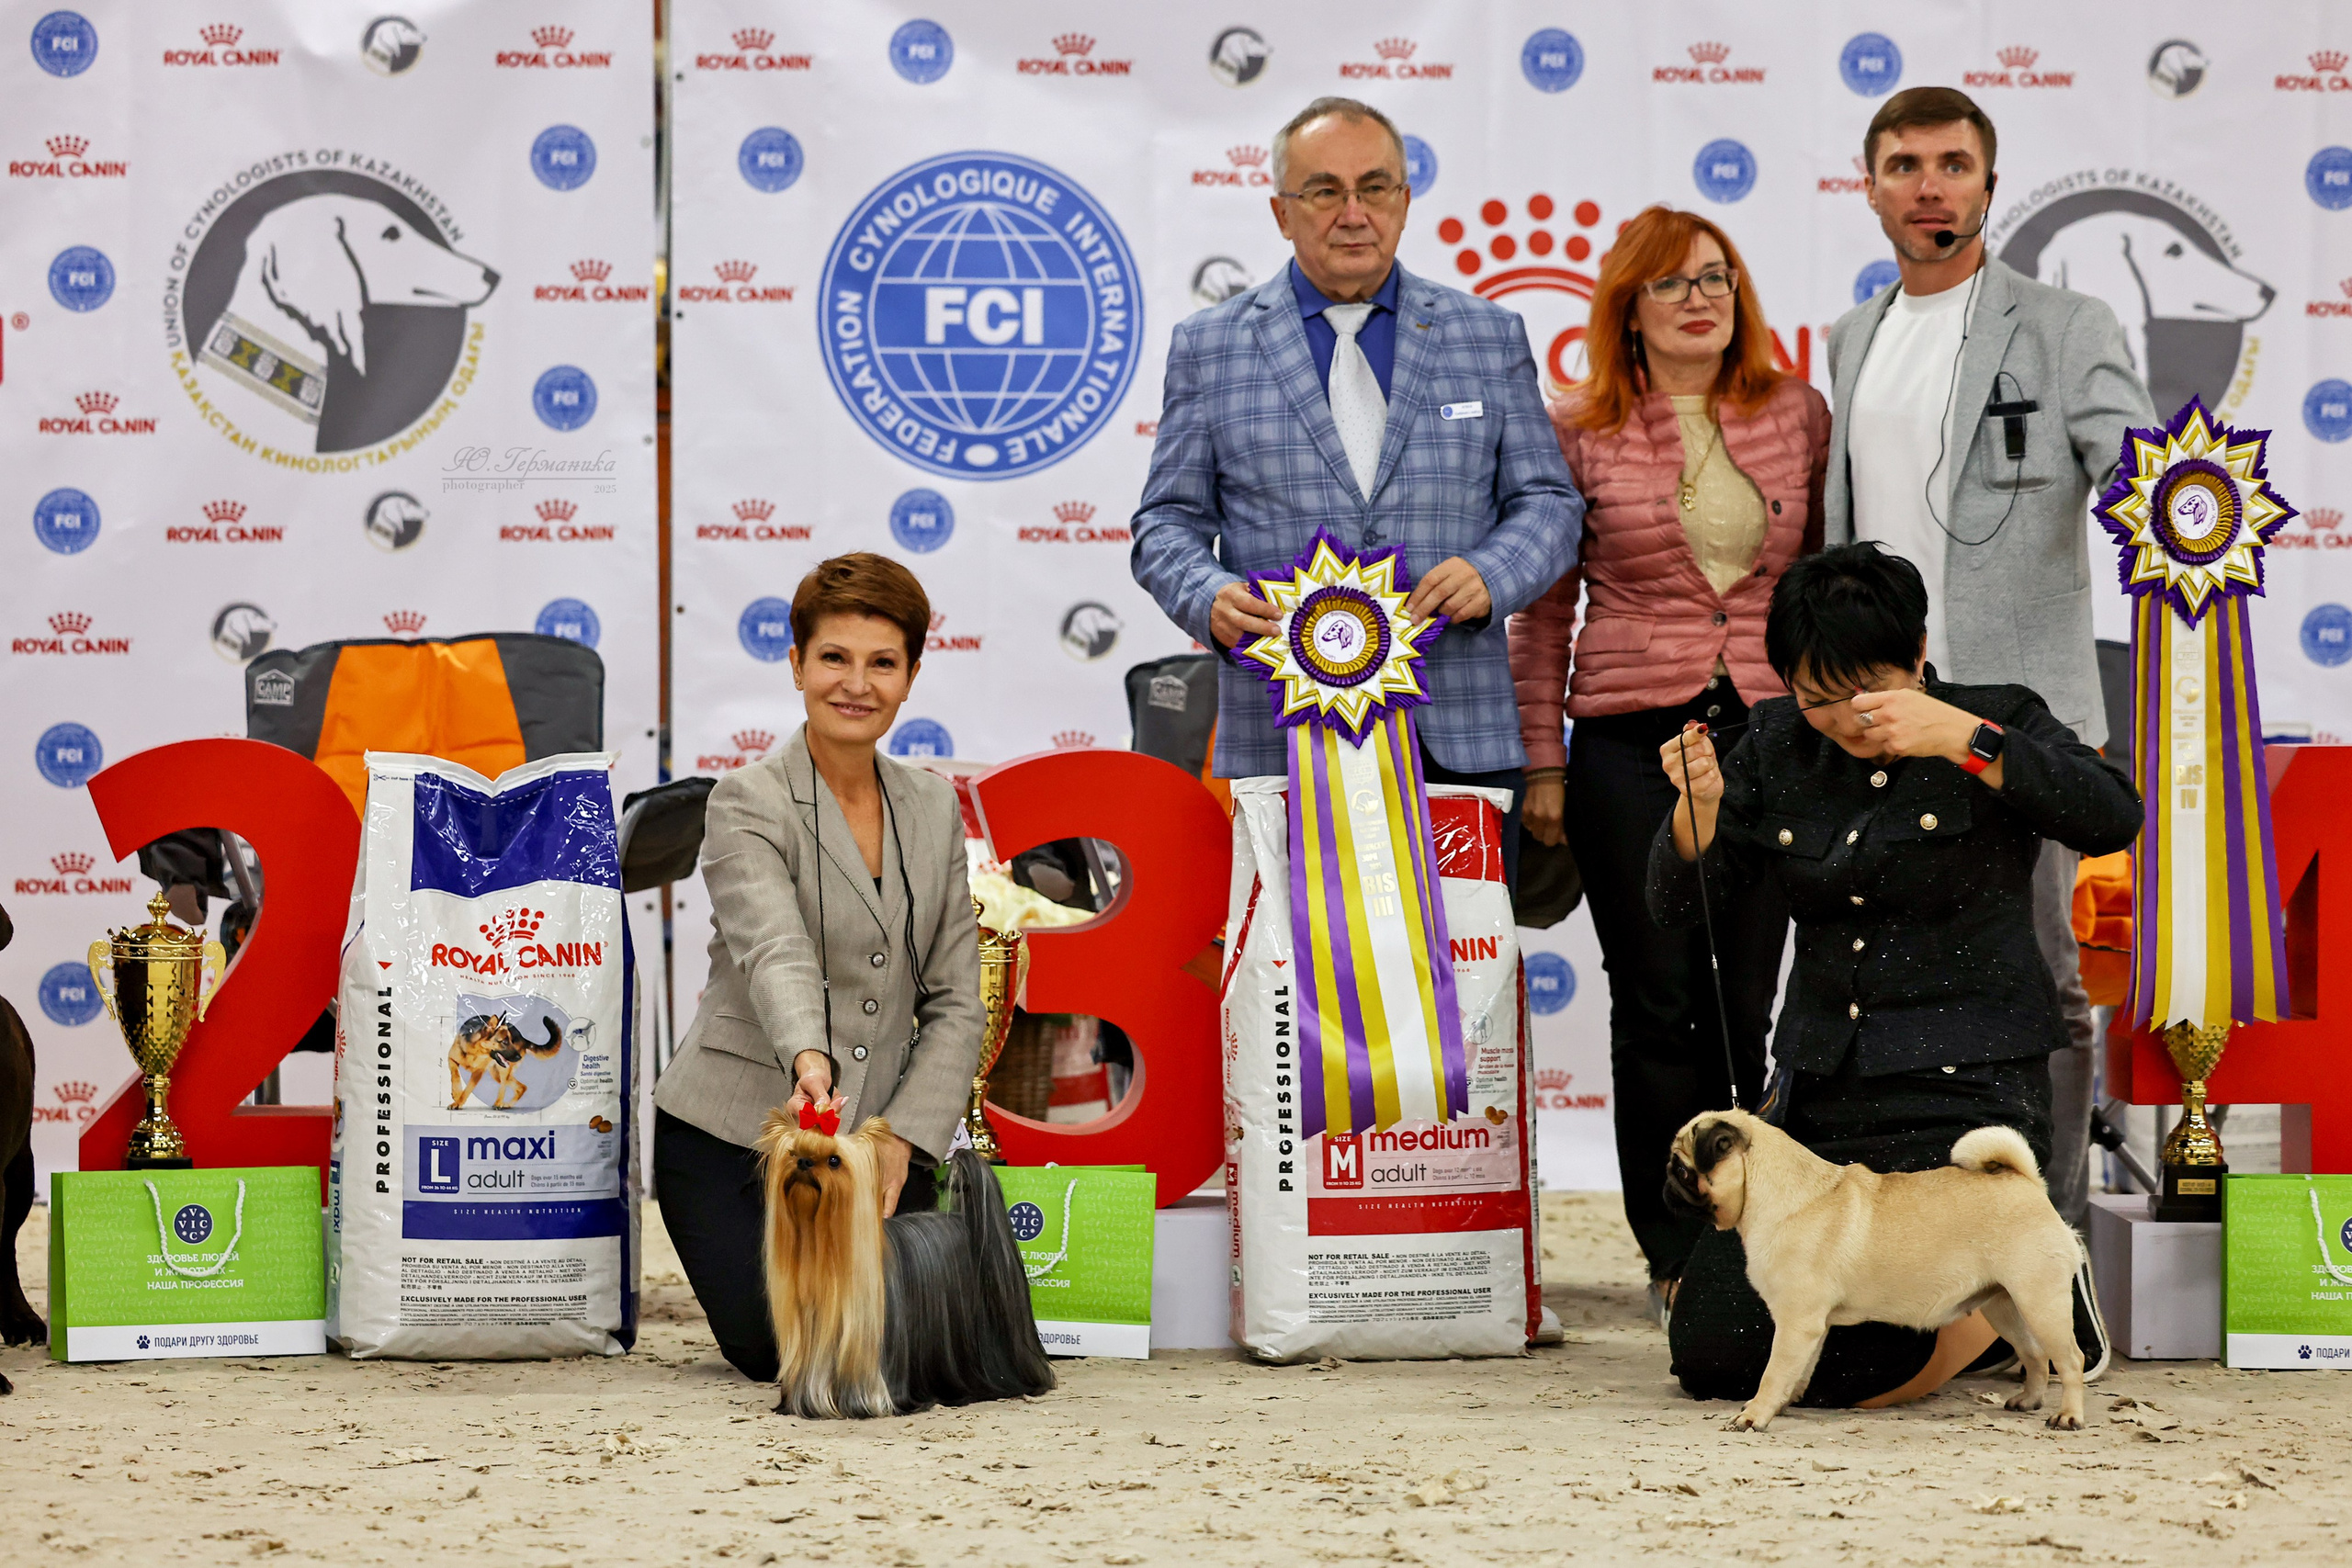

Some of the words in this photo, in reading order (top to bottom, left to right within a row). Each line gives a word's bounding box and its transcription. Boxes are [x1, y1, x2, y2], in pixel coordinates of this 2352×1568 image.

[51, 36, 78, 51] FCI
[164, 51, 216, 66] ROYAL
[910, 44, 934, 59] FCI
[496, 52, 548, 67] ROYAL
[696, 55, 748, 70] ROYAL
[1018, 60, 1069, 74] ROYAL
[315, 149, 343, 164] OF
[551, 151, 577, 164] FCI
[758, 152, 785, 166] FCI
[9, 161, 62, 177] ROYAL
[185, 150, 309, 240] CYNOLOGISTS
[349, 152, 464, 243] KAZAKHSTAN
[1990, 169, 2098, 253] YNOLOGISTS
[848, 168, 1060, 273] CYNOLOGIQUE
[169, 242, 188, 271] OF
[69, 271, 96, 286] FCI
[534, 286, 586, 300] ROYAL
[679, 288, 730, 301] ROYAL
[163, 276, 181, 348] UNION
[924, 287, 1045, 345] FCI
[1004, 210, 1127, 465] INTERNATIONALE
[836, 289, 958, 464] FEDERATION
[553, 391, 579, 405] FCI
[39, 418, 92, 434] ROYAL
[54, 513, 81, 528] FCI
[910, 513, 935, 527] FCI
[166, 526, 219, 543] ROYAL
[225, 526, 283, 542] CANIN
[499, 526, 551, 541] ROYAL
[696, 525, 748, 540] ROYAL
[1018, 527, 1069, 542] ROYAL
[758, 622, 785, 637] FCI
[11, 638, 65, 655] ROYAL
[71, 638, 130, 654] CANIN
[257, 681, 291, 700] CAMP
[57, 748, 84, 763] FCI
[2174, 764, 2203, 785] BIS
[2180, 788, 2198, 809] IV
[14, 878, 69, 896] ROYAL
[74, 878, 132, 895] CANIN
[1362, 872, 1396, 896] BIS
[1373, 896, 1394, 917] III
[79, 737, 368, 1171] 2
[431, 942, 510, 976] ROYAL
[517, 941, 602, 968] CANIN
[967, 746, 1236, 1209] 3
[59, 987, 85, 1001] FCI
[583, 1055, 609, 1064] Digestive
[376, 986, 392, 1194] PROFESSIONAL
[1275, 985, 1294, 1192] PROFESSIONAL
[467, 1130, 555, 1160] maxi
[1369, 1124, 1489, 1152] medium
[430, 1148, 451, 1183] L
[1330, 1145, 1357, 1179] M
[467, 1170, 525, 1188] adult
[1371, 1163, 1427, 1182] adult
[1231, 1191, 1240, 1259] medium
[146, 1253, 199, 1264] ЗДОРОВЬЕ
[154, 1268, 163, 1277] И
[147, 1280, 178, 1291] НАША
[181, 1279, 244, 1290] ПРОФЕССИЯ
[1028, 1278, 1070, 1288] ФЕССИЯ
[1417, 1288, 1472, 1296] PROFESSIONAL
[2311, 1292, 2344, 1301] НАША
[154, 1337, 187, 1348] ПОДАРИ
[189, 1336, 215, 1348] ДРУГУ
[217, 1334, 259, 1346] ЗДОРОВЬЕ
[1038, 1333, 1081, 1345] ЗДОРОВЬЕ
[2316, 1348, 2350, 1359] ПОДАРИ
